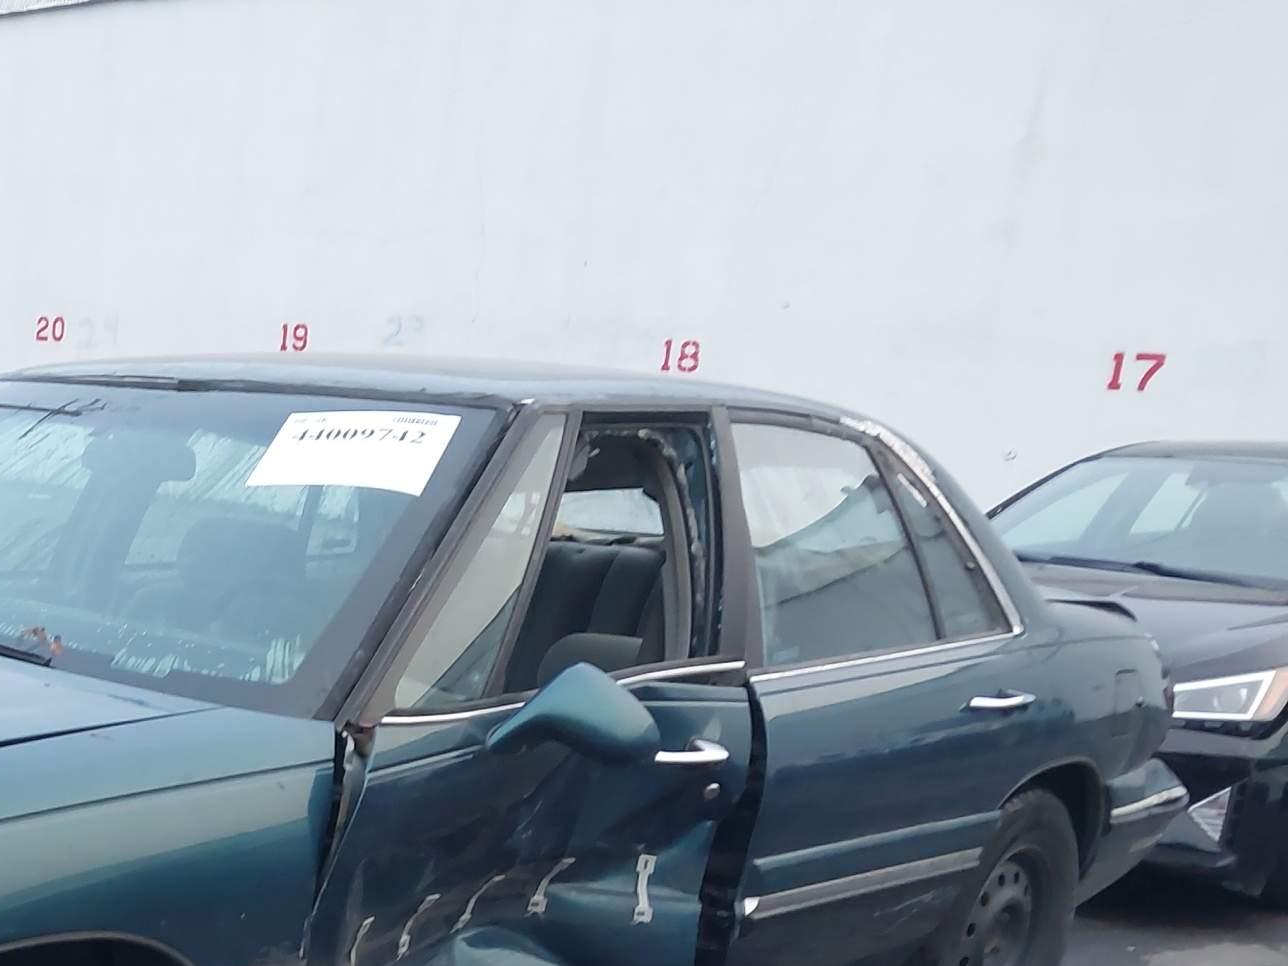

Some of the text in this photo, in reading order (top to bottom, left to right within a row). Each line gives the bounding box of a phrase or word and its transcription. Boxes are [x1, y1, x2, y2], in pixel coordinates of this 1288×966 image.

[34, 314, 66, 344] 20
[279, 323, 309, 352] 19
[661, 339, 700, 373] 18
[1105, 352, 1167, 392] 17
[291, 427, 427, 445] 44009742
